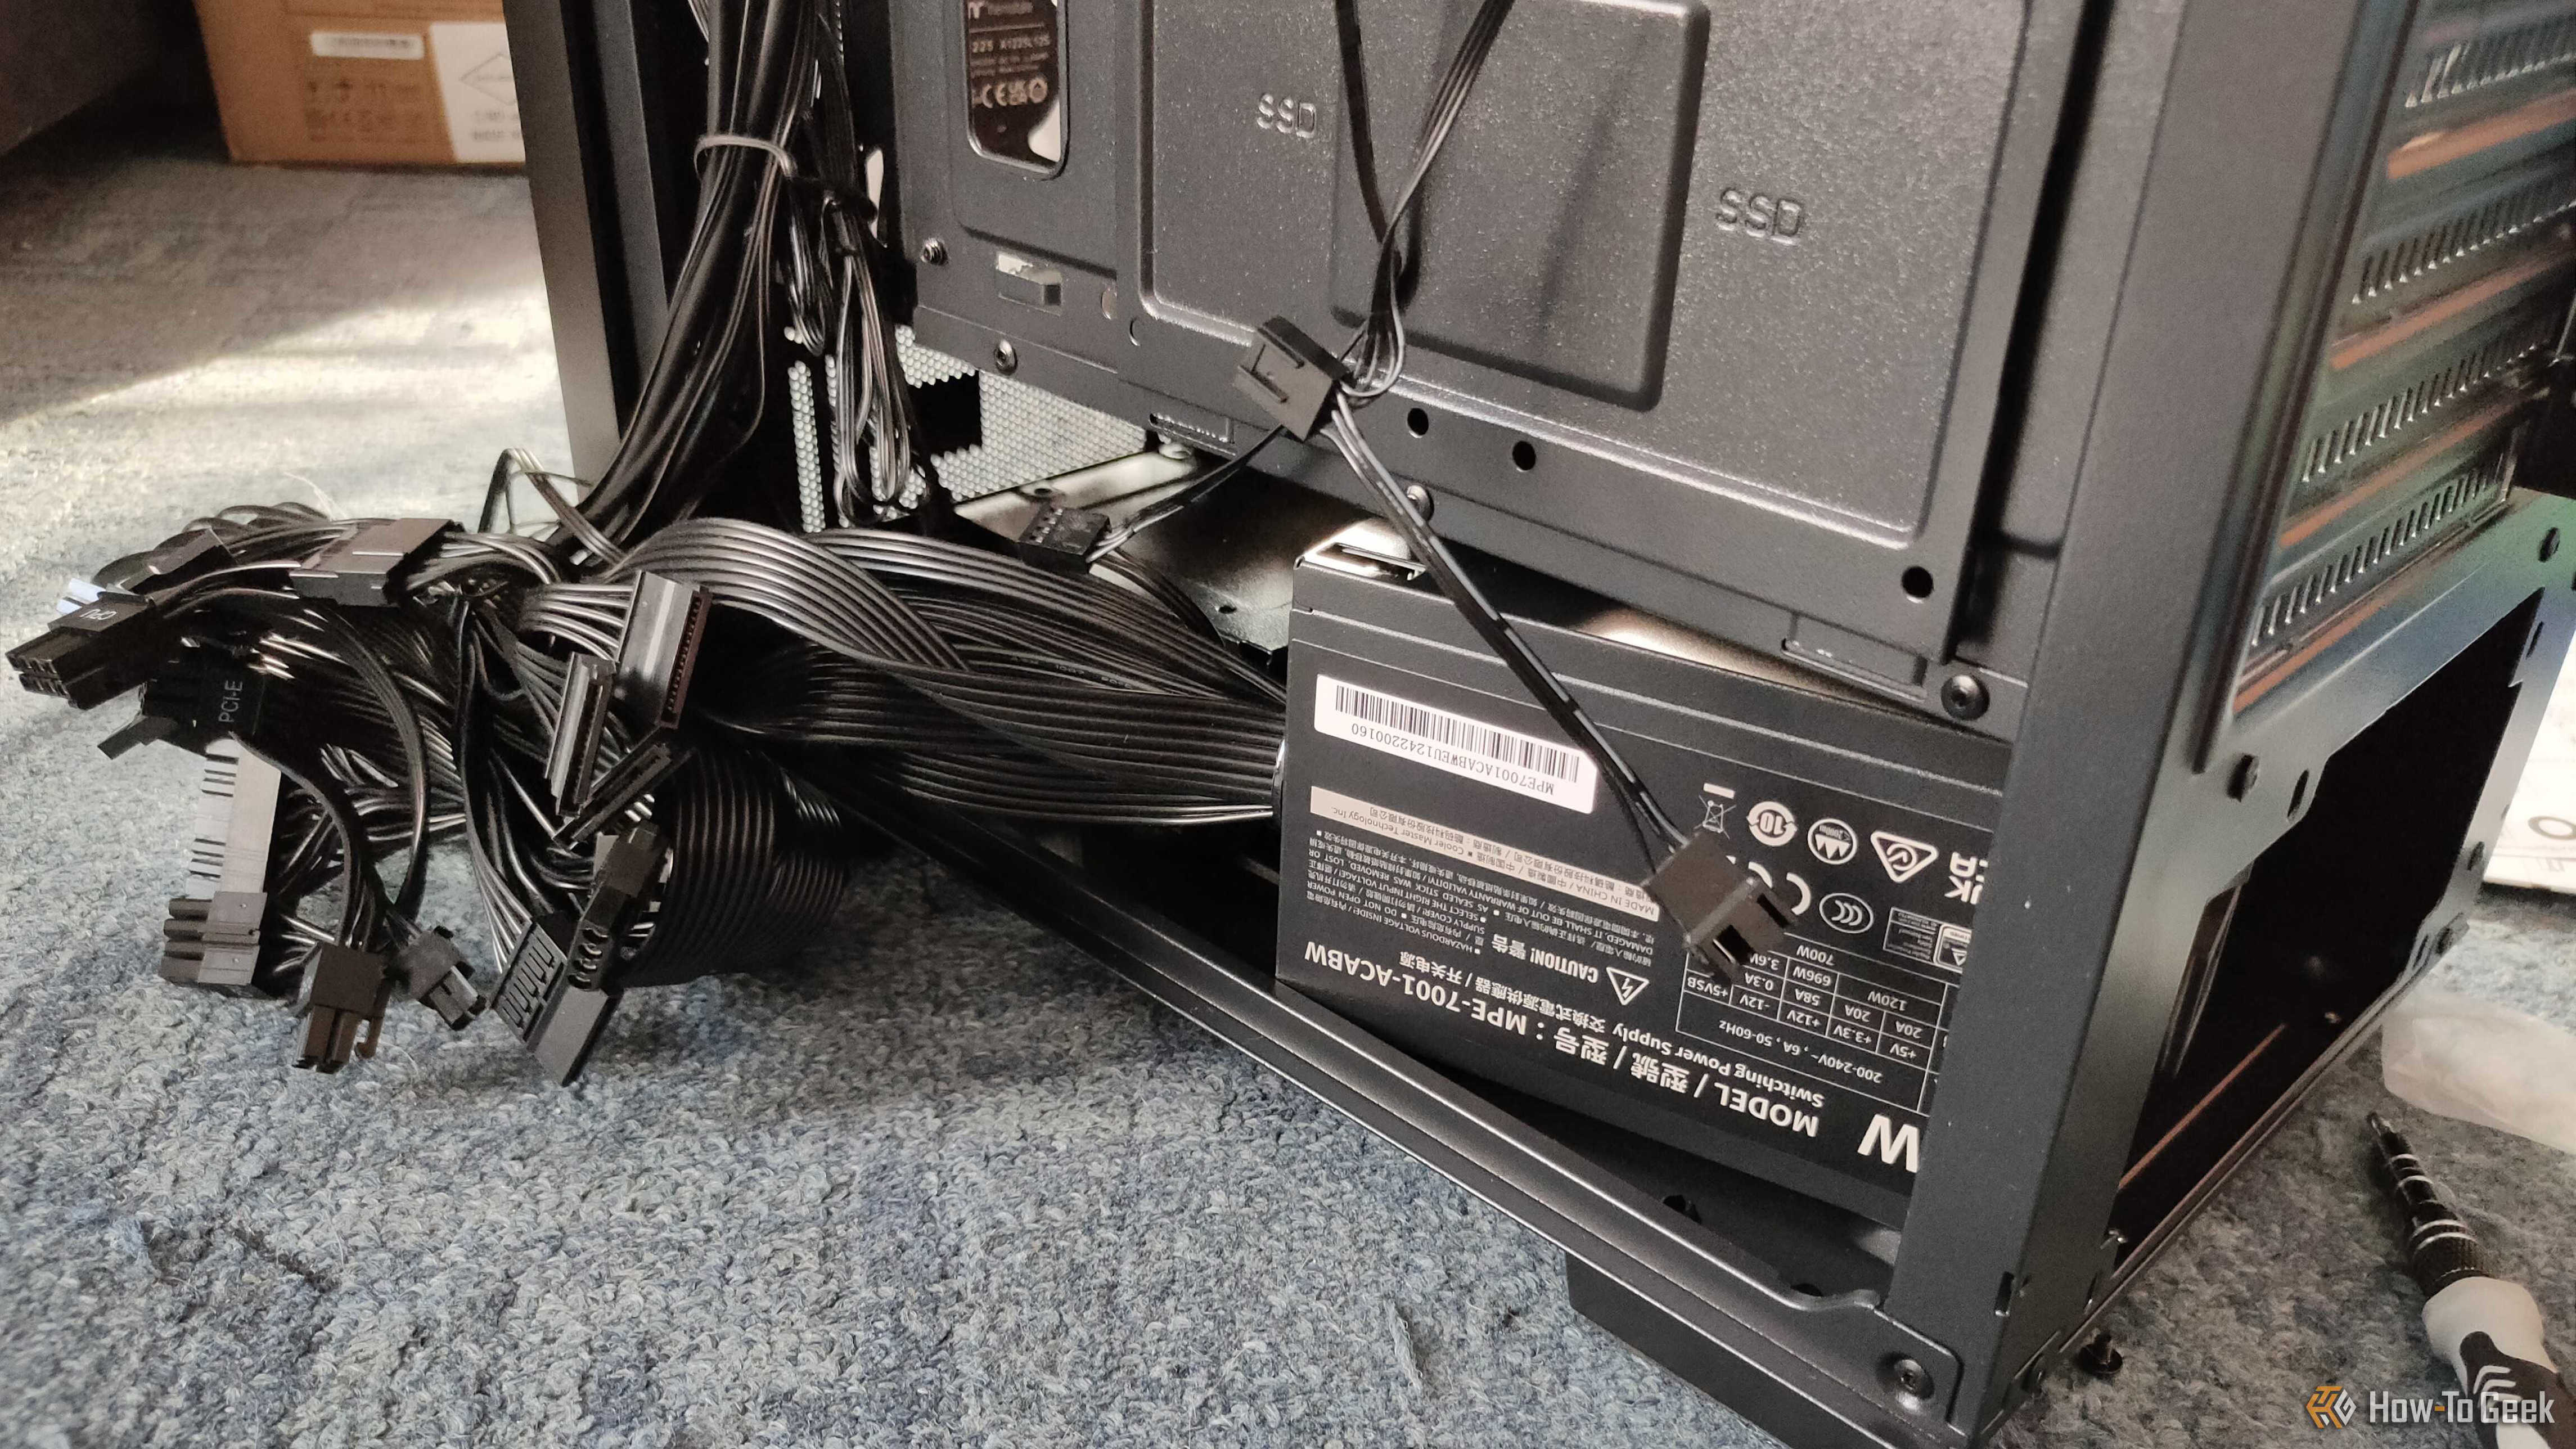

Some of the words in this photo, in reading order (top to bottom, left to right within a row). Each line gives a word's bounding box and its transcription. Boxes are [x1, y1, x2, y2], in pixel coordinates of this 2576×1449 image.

[1256, 94, 1317, 138] SSD
[1715, 187, 1803, 246] SSD
[79, 609, 117, 620] CPU
[218, 680, 243, 723] PCI-E
[1350, 722, 1554, 795] MPE7001ACABWEU1242200160
[1331, 806, 1346, 818] Inc.
[1348, 810, 1399, 835] Technology
[1758, 811, 1785, 837] 10
[1400, 829, 1432, 845] Master
[1308, 848, 1320, 858] OR
[1435, 839, 1463, 856] Cooler
[1324, 853, 1344, 866] LOST
[1339, 868, 1377, 888] VOLTAGE!
[1347, 860, 1389, 881] REMOVED,
[1306, 879, 1335, 896] POWER
[1377, 881, 1403, 897] INPUT
[1393, 876, 1411, 889] WAS
[1415, 883, 1438, 897] STICK
[1427, 875, 1467, 895] VALIDITY!
[1338, 890, 1360, 904] OPEN
[1403, 890, 1430, 906] RIGHT
[1442, 892, 1473, 909] SEALED
[1467, 888, 1516, 911] WARRANTY
[1575, 884, 1607, 901] CHINA
[1610, 894, 1621, 904] IN
[1353, 906, 1381, 922] INSIDE!
[1364, 899, 1381, 911] NOT
[1384, 906, 1397, 916] DO
[1430, 899, 1447, 911] THE
[1448, 905, 1478, 921] SELECT
[1476, 903, 1488, 914] AS
[1517, 904, 1529, 915] OF
[1624, 899, 1654, 915] MADE
[1422, 907, 1452, 924] COVER!
[1530, 908, 1550, 922] OUT
[1551, 915, 1562, 926] BE
[1383, 916, 1420, 935] VOLTAGE
[1454, 918, 1485, 935] SUPPLY
[1564, 919, 1592, 935] SHALL
[1593, 929, 1602, 939] IT
[1421, 929, 1472, 952] HAZARDOUS
[1490, 933, 1527, 960] 警告
[1602, 932, 1653, 955] DAMAGED,
[1796, 943, 1836, 966] 700W
[1398, 948, 1463, 985] 开关电源
[1529, 947, 1598, 983] CAUTION!
[1744, 971, 1774, 991] 0.3A
[1793, 965, 1831, 987] 696W
[1304, 939, 1528, 1036] MPE-7001-ACABW
[1686, 975, 1728, 999] +5VSB
[1474, 975, 1606, 1034] 交換式電源供應器
[1739, 992, 1770, 1012] -12V
[1793, 987, 1821, 1007] 58A
[1867, 988, 1907, 1012] 120W
[1786, 1008, 1821, 1029] +12V
[1843, 1004, 1871, 1023] 20A
[1611, 1019, 1673, 1056] Supply
[1718, 1019, 1773, 1047] 50-60Hz
[1832, 1023, 1872, 1046] +3.3V
[1894, 1019, 1922, 1038] 20A
[1782, 1041, 1800, 1056] 6A
[1889, 1042, 1917, 1060] +5V
[1674, 1045, 1731, 1077] Power
[1629, 1051, 1690, 1094] 型號
[1732, 1061, 1825, 1109] Switching
[1711, 1081, 1819, 1138] MODEL
